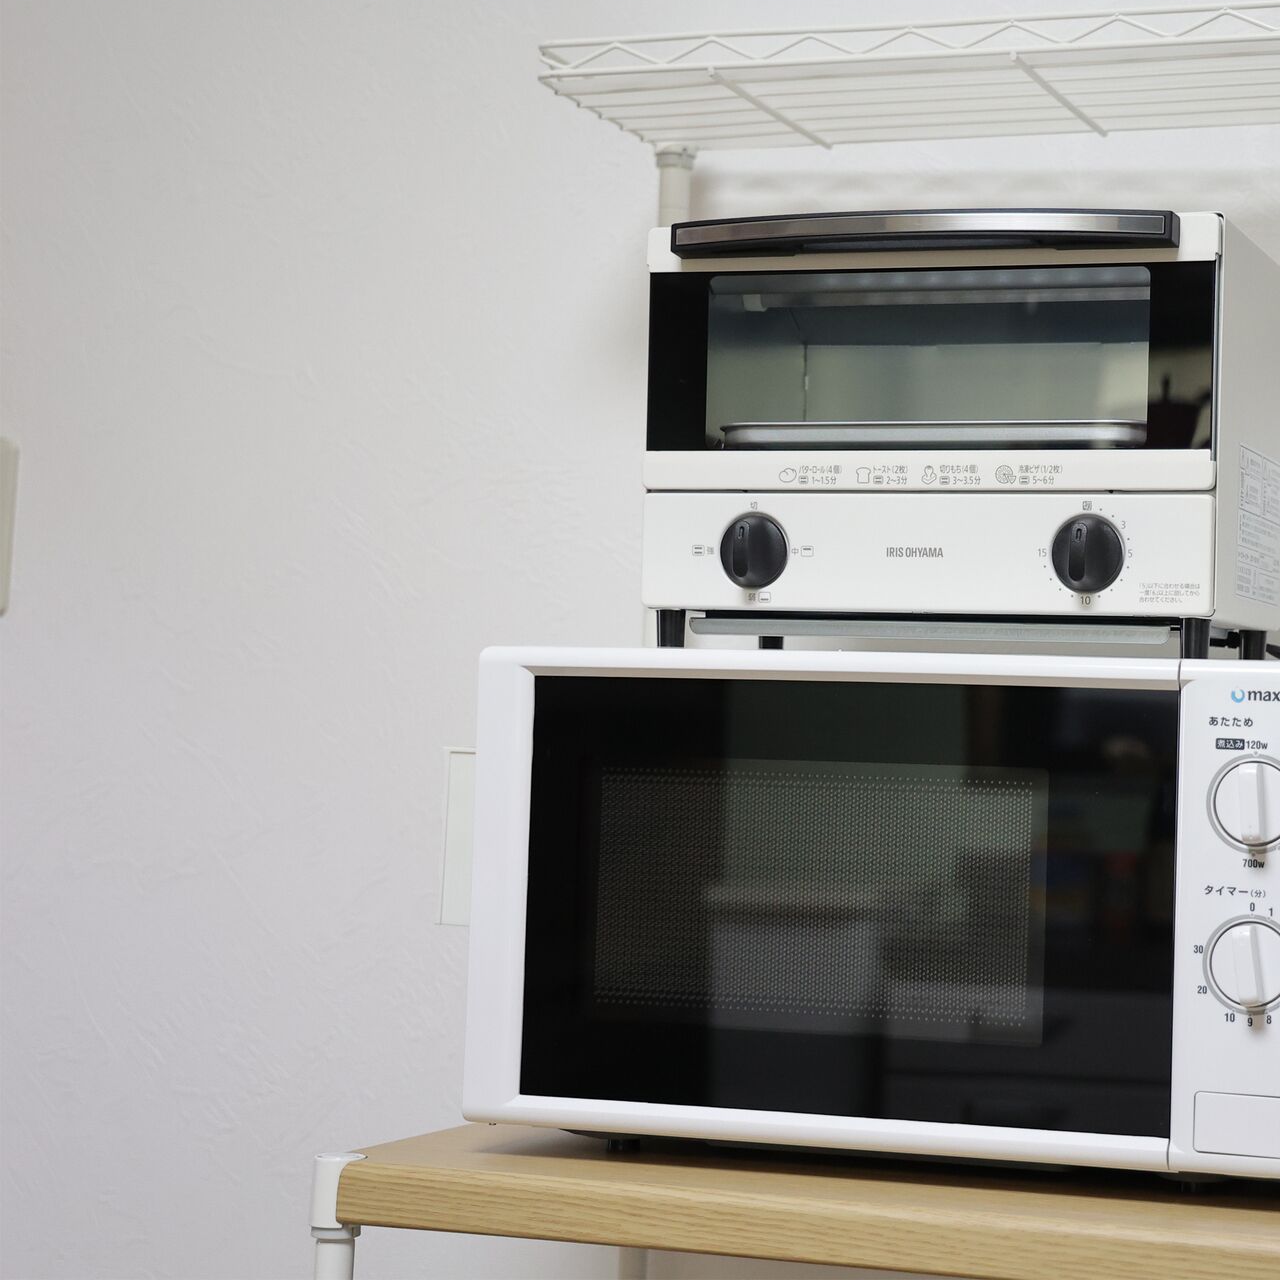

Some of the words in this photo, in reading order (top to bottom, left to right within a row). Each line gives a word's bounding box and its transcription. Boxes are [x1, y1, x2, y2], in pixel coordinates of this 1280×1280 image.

[1120, 520, 1127, 530] 3
[885, 545, 904, 559] IRIS
[904, 545, 944, 559] OHYAMA
[1037, 548, 1048, 558] 15
[1127, 549, 1134, 559] 5
[1080, 595, 1092, 606] 10
[1208, 715, 1254, 728] あたため
[1246, 740, 1269, 751] 120w
[1242, 858, 1266, 869] 700w
[1249, 901, 1256, 912] 0
[1268, 907, 1274, 917] 1
[1193, 944, 1205, 955] 30
[1197, 985, 1209, 996] 20
[1224, 1012, 1236, 1023] 10
[1246, 1017, 1254, 1028] 9
[1265, 1014, 1273, 1026] 8
